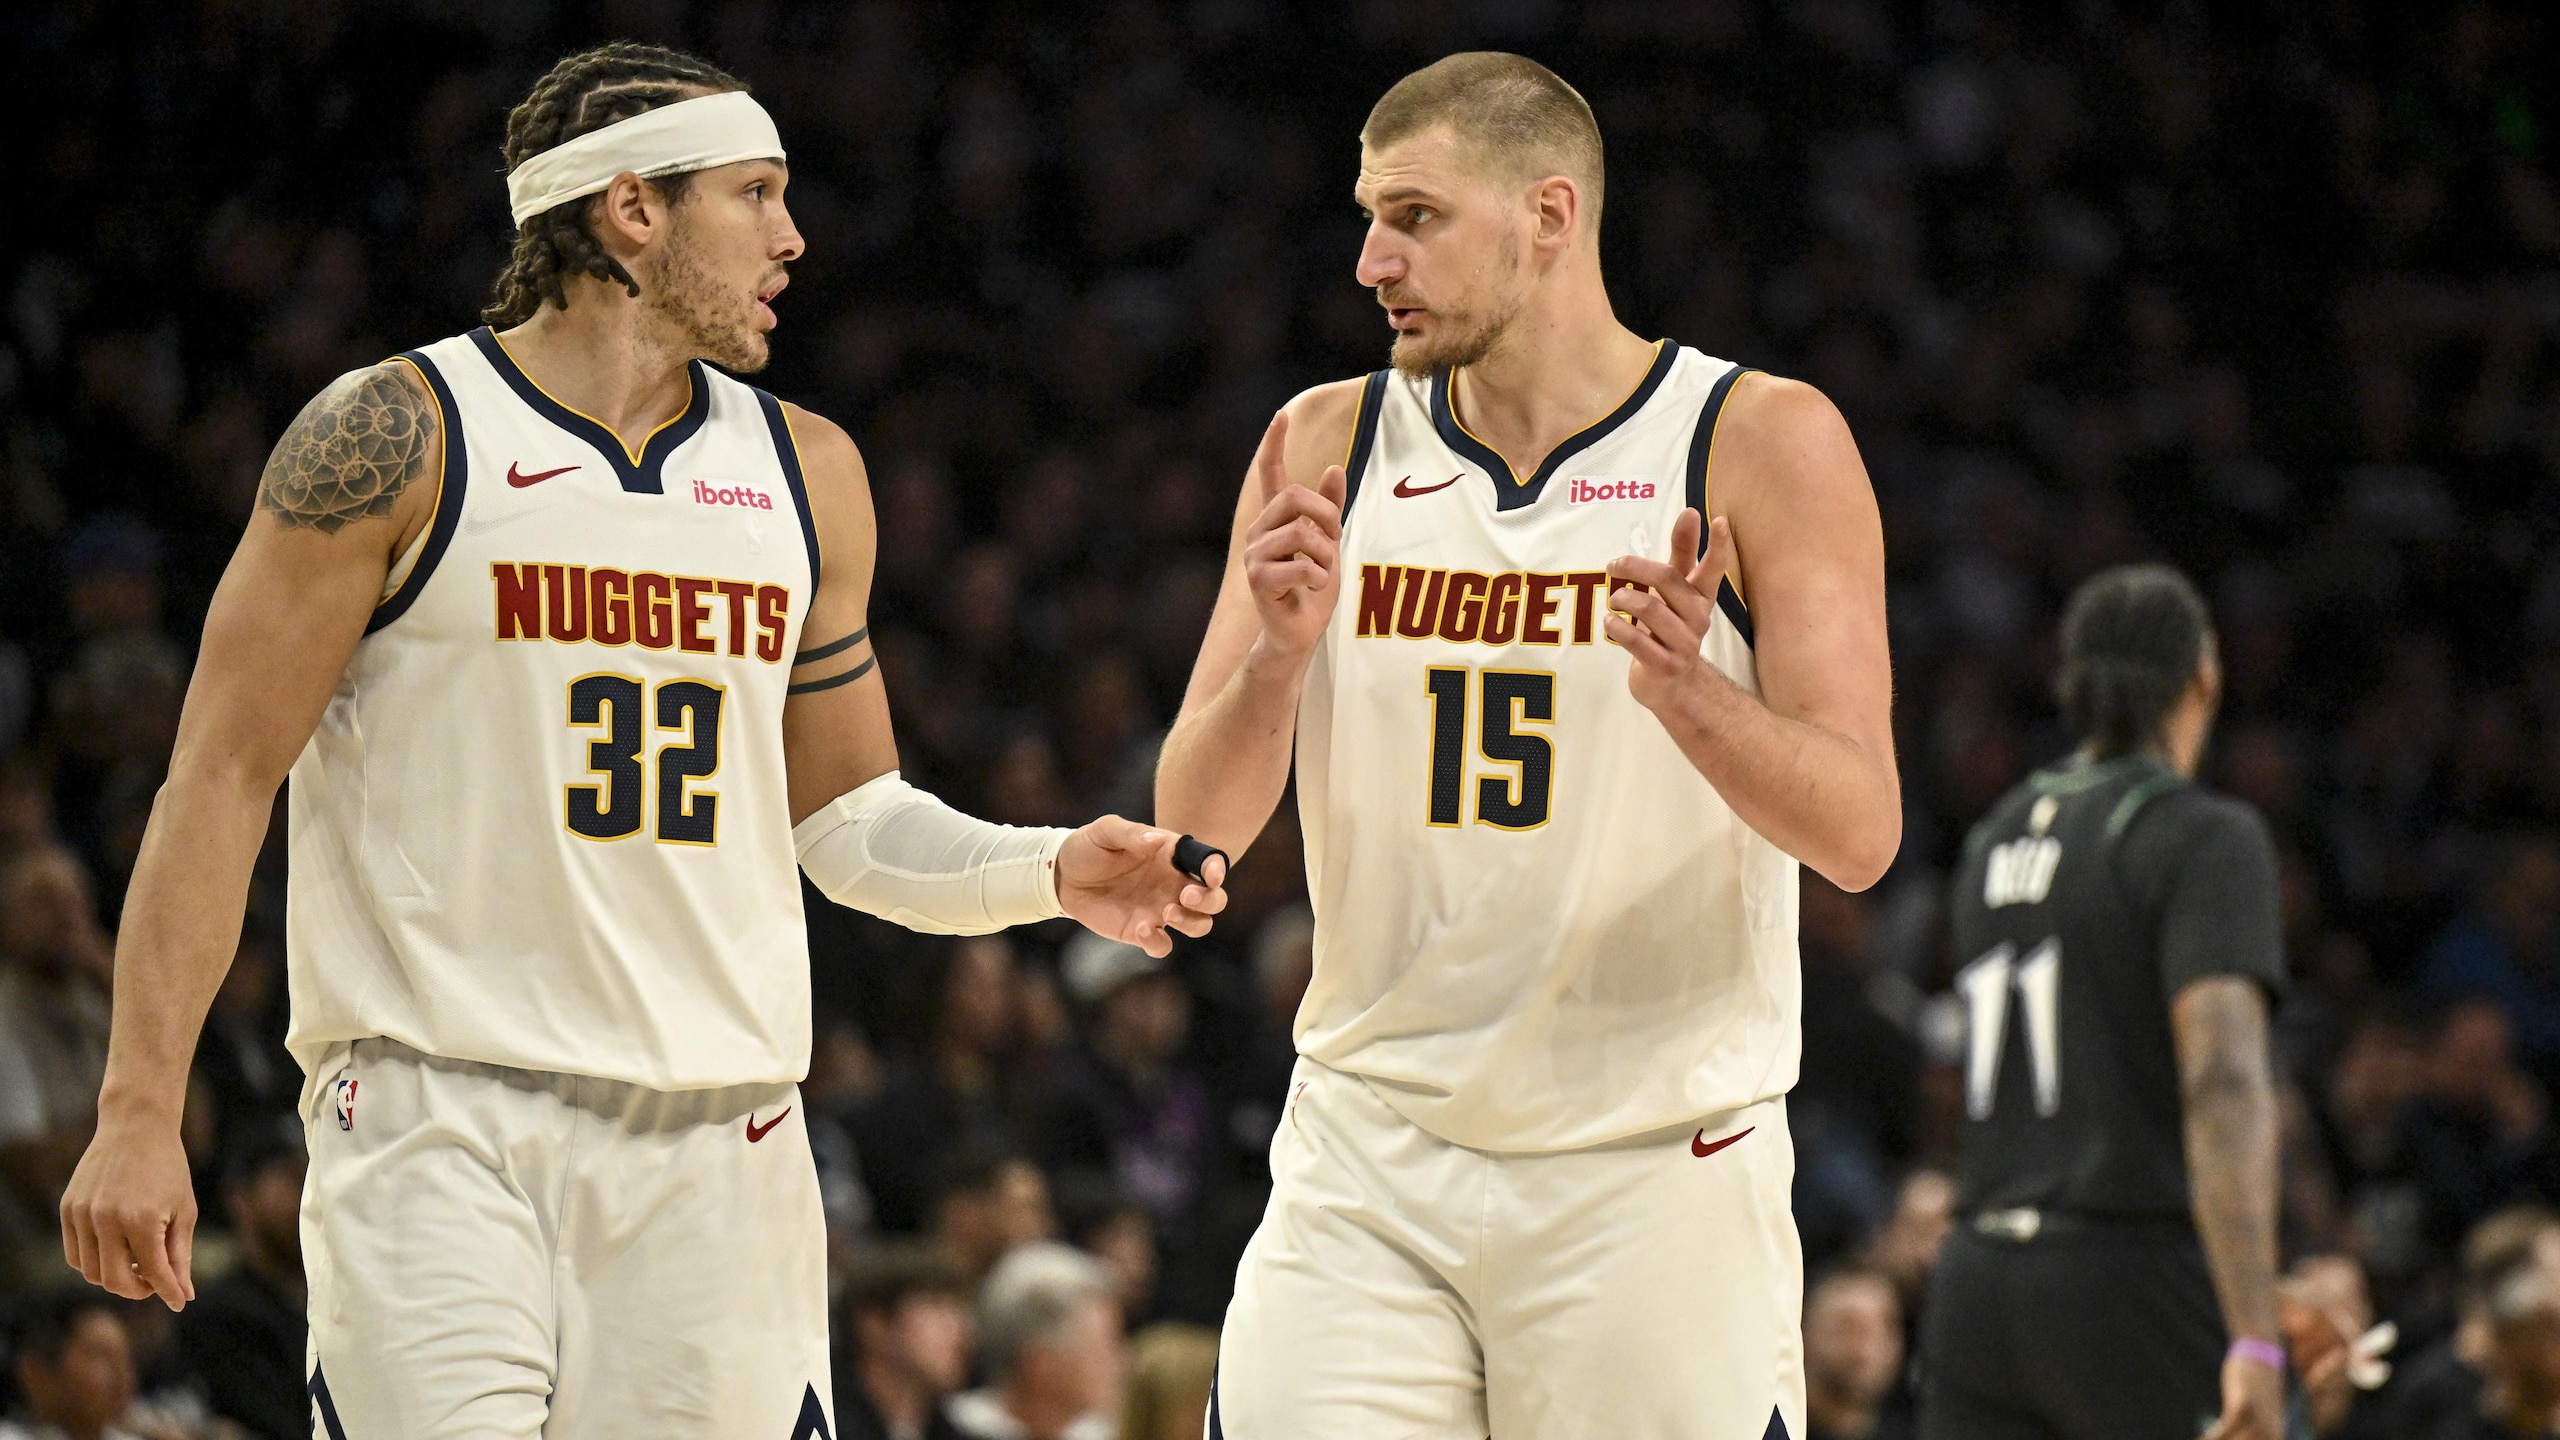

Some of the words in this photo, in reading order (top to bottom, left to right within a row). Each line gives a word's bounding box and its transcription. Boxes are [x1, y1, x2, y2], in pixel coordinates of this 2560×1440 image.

[692, 479, 773, 510] ibotta
[1570, 479, 1655, 503] ibotta
[490, 561, 790, 664] NUGGETS
[564, 671, 727, 848] 32
[1424, 664, 1557, 832] 15
[1956, 935, 2063, 1122] 11
